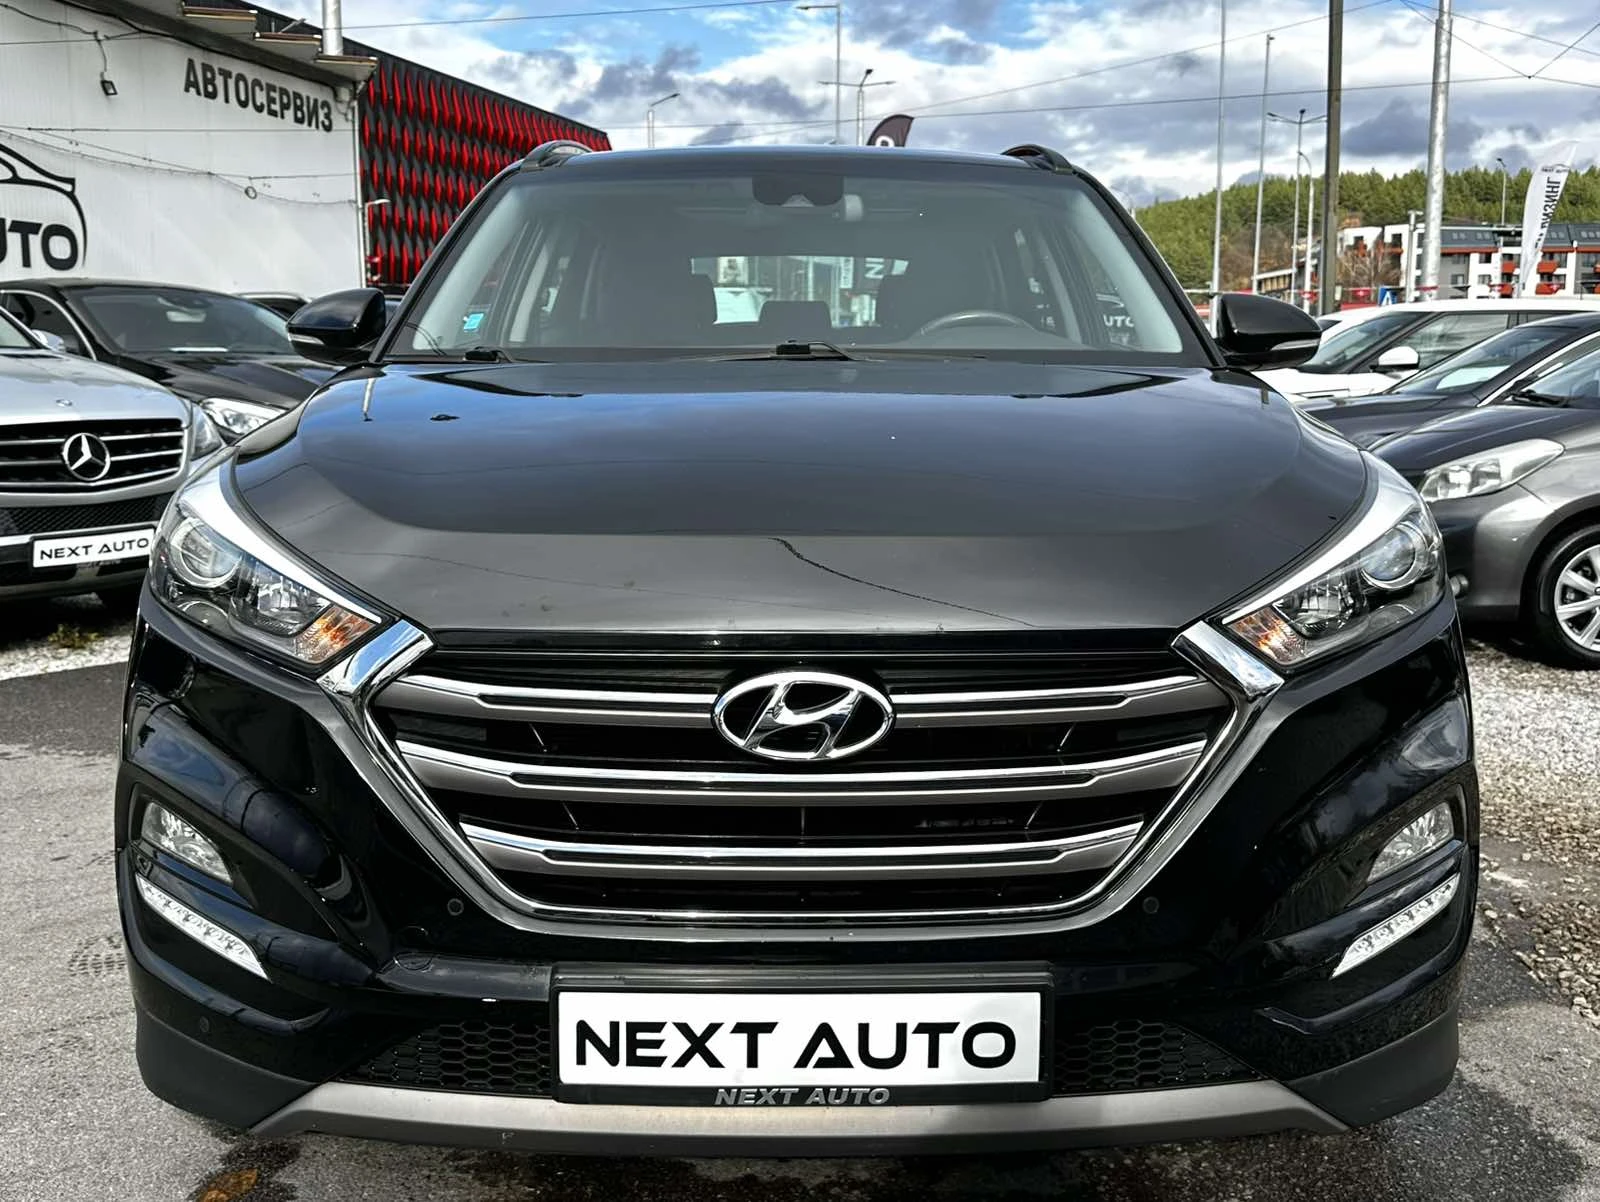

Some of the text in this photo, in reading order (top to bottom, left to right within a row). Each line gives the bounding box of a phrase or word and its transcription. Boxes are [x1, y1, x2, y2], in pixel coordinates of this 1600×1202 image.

[184, 58, 333, 133] АВТОСЕРВИЗ
[0, 217, 79, 271] TO
[40, 538, 149, 560] NEXT AUTO
[576, 1018, 1017, 1070] NEXT AUTO
[714, 1087, 890, 1106] NEXT AUTO
